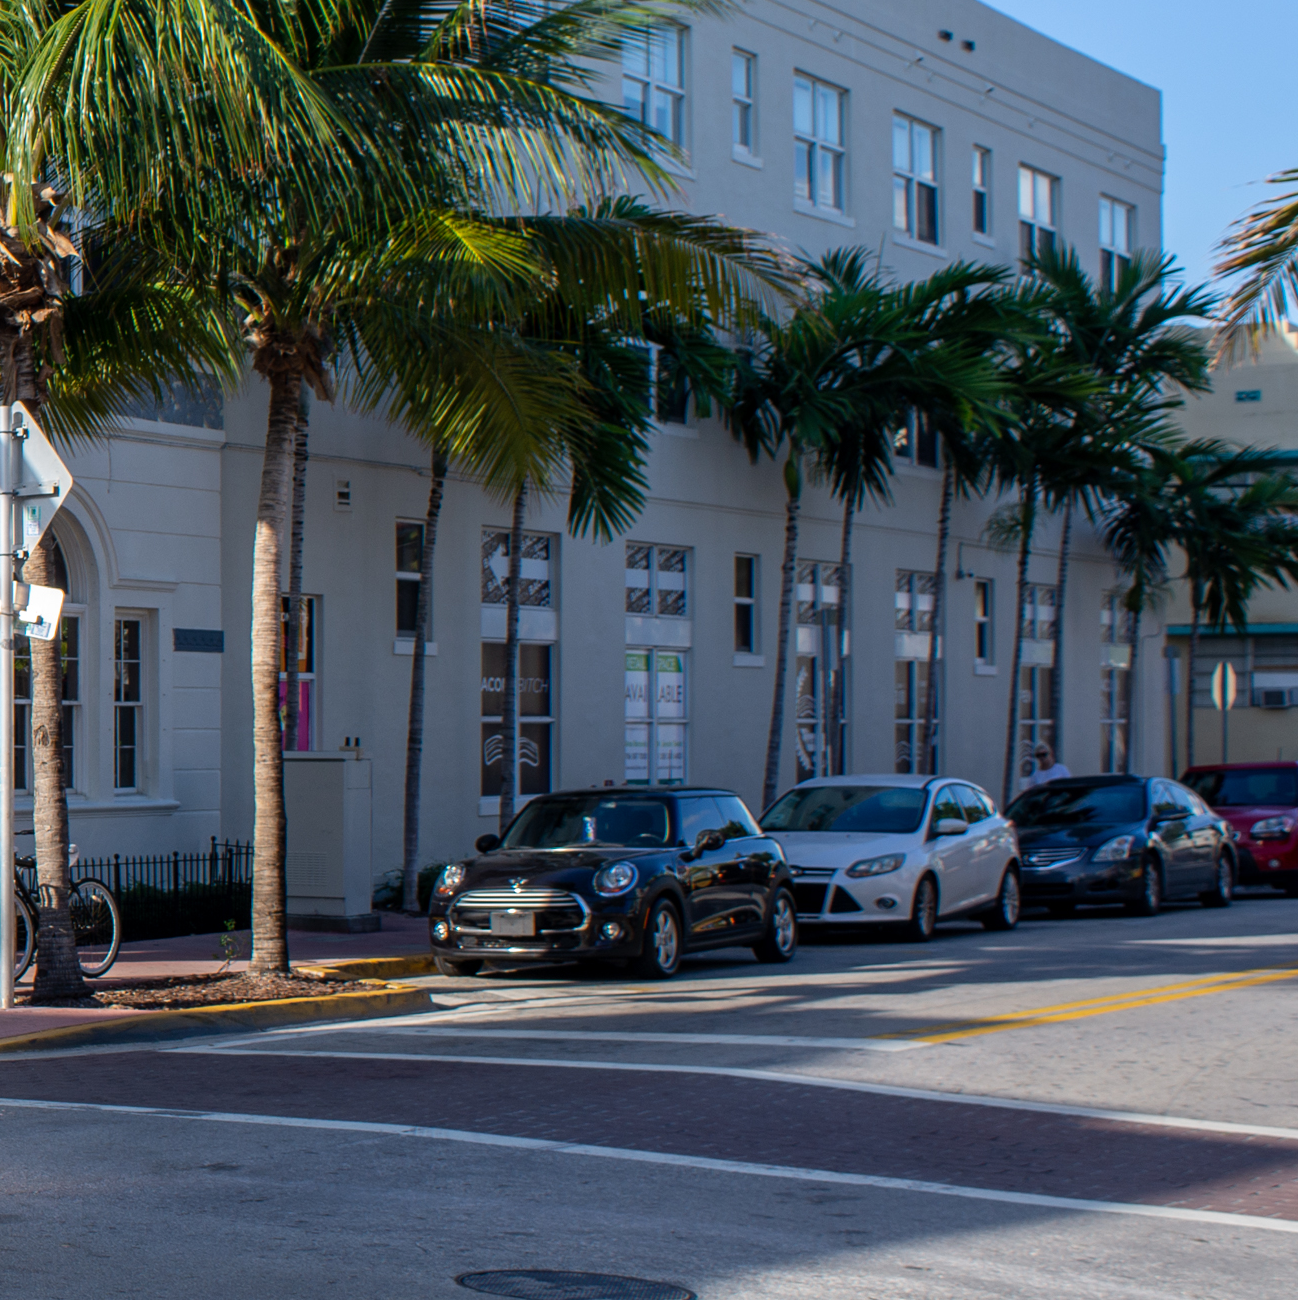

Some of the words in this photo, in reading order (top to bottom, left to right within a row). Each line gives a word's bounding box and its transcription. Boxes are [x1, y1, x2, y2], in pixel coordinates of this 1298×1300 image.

[480, 677, 505, 692] ACO
[517, 677, 549, 693] BITCH
[625, 684, 683, 703] AVAIABLE
